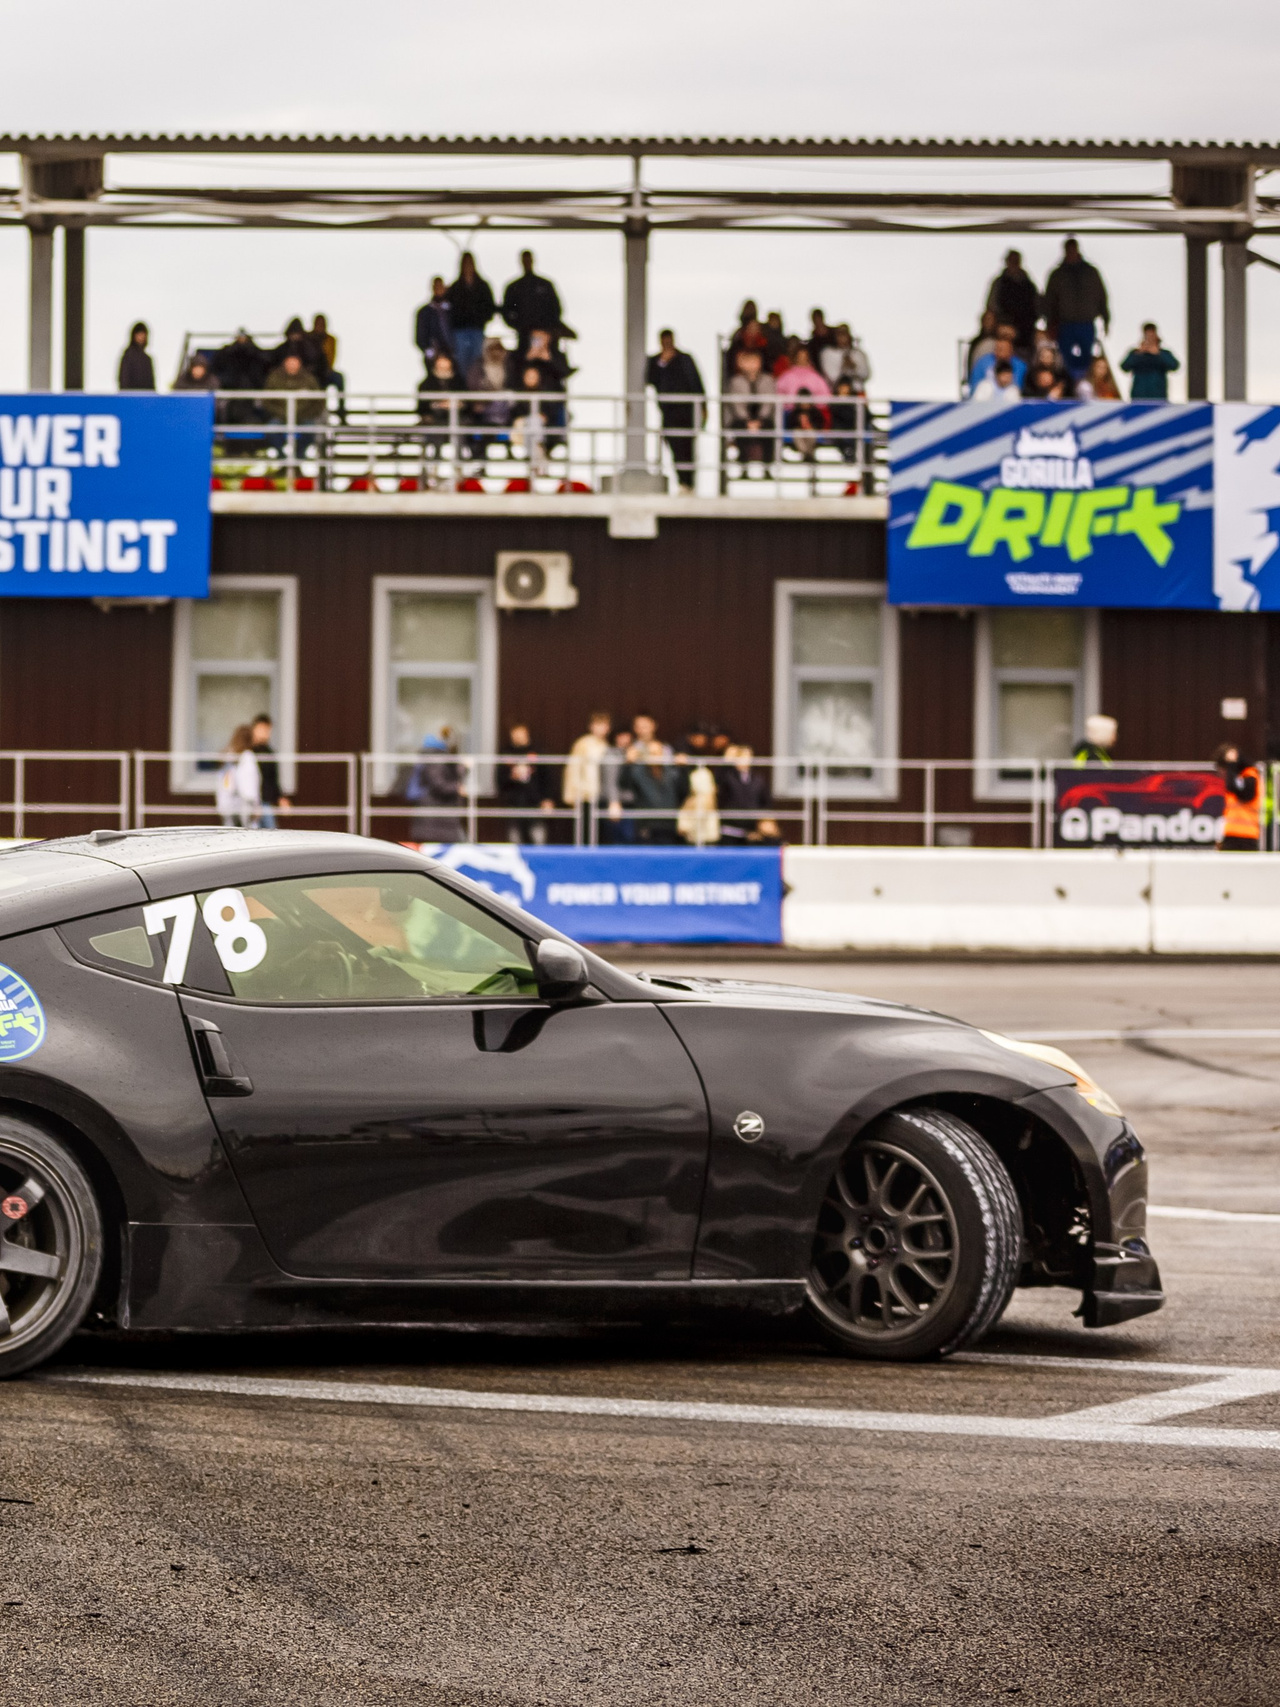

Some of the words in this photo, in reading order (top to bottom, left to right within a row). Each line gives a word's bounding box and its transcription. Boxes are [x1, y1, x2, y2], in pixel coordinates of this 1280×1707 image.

[1001, 457, 1095, 489] GORILLA
[905, 480, 1181, 569] DRIFT
[1091, 807, 1226, 843] Pandor
[546, 882, 618, 906] POWER
[620, 882, 670, 906] YOUR
[674, 881, 762, 905] INSTINCT
[142, 887, 268, 985] 78
